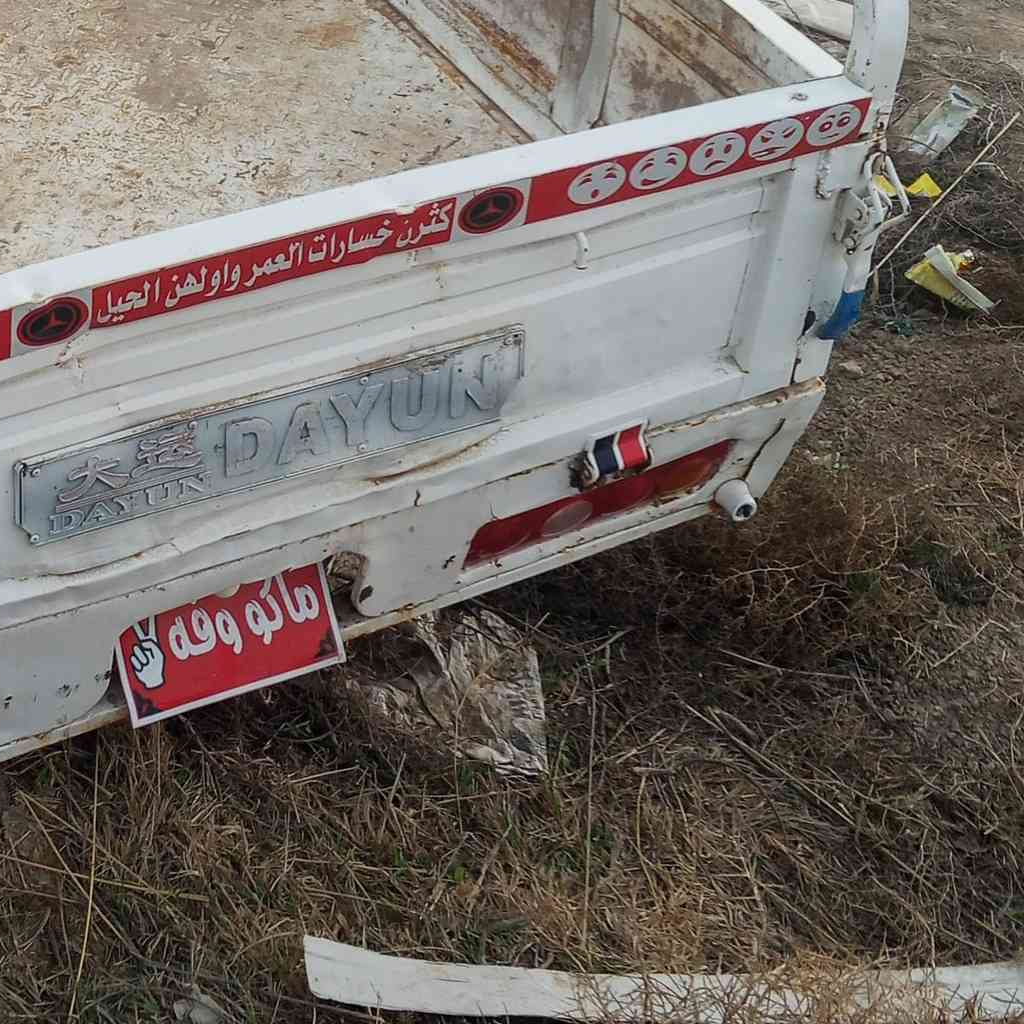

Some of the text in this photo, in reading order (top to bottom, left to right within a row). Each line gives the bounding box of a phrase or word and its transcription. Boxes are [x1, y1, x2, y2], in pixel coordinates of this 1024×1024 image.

[248, 239, 304, 288] العمر
[308, 216, 392, 264] خسارات
[96, 275, 161, 324] الحيل
[222, 352, 509, 477] DAYUN
[48, 470, 214, 537] DAYUN
